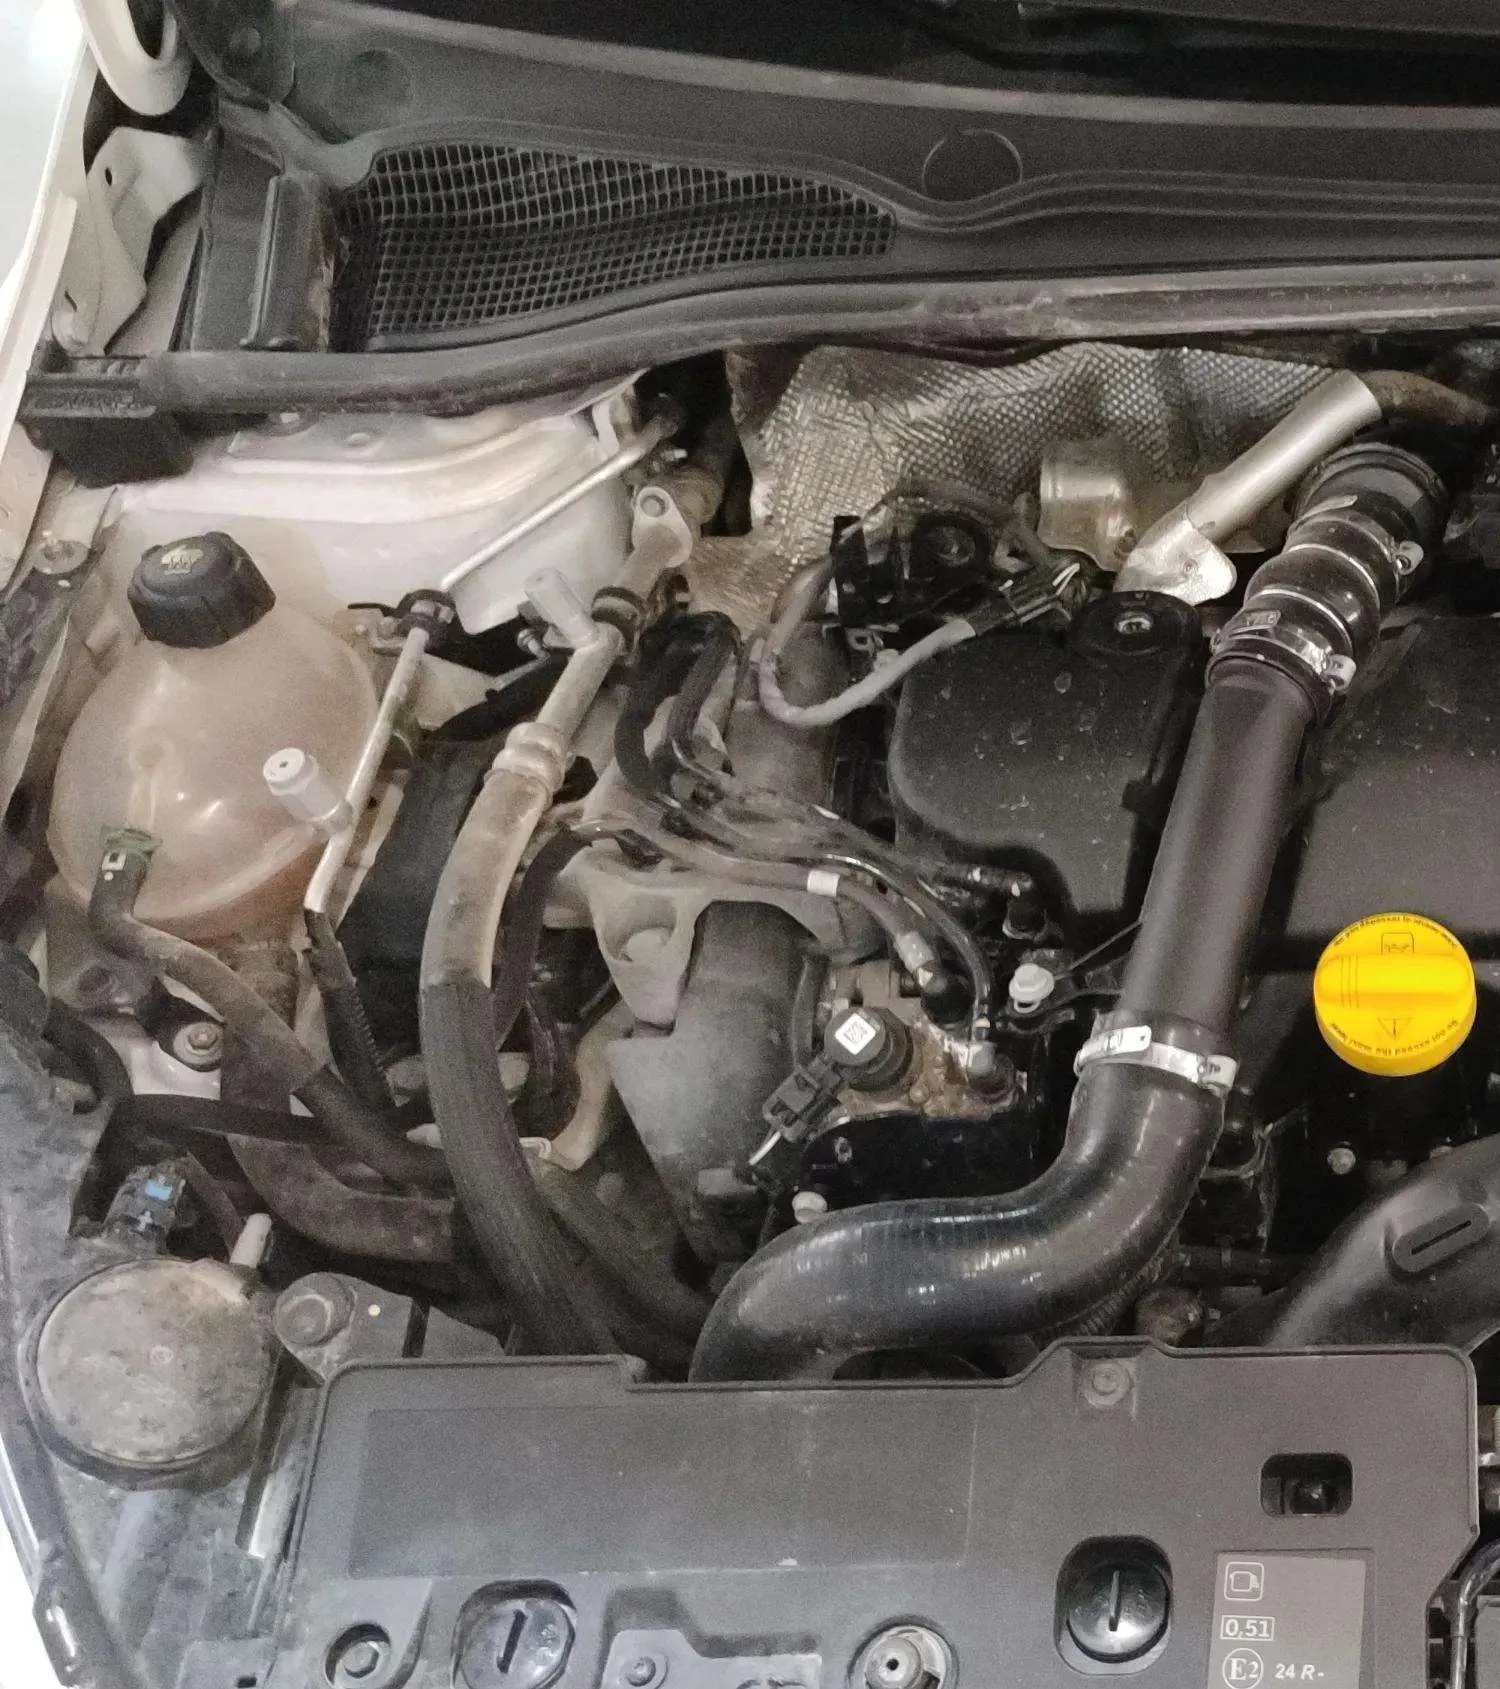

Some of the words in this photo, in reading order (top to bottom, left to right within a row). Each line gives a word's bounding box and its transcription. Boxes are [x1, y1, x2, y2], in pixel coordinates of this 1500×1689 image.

[1225, 1618, 1270, 1639] 0,51
[1229, 1658, 1259, 1681] E2
[1275, 1664, 1296, 1680] 24
